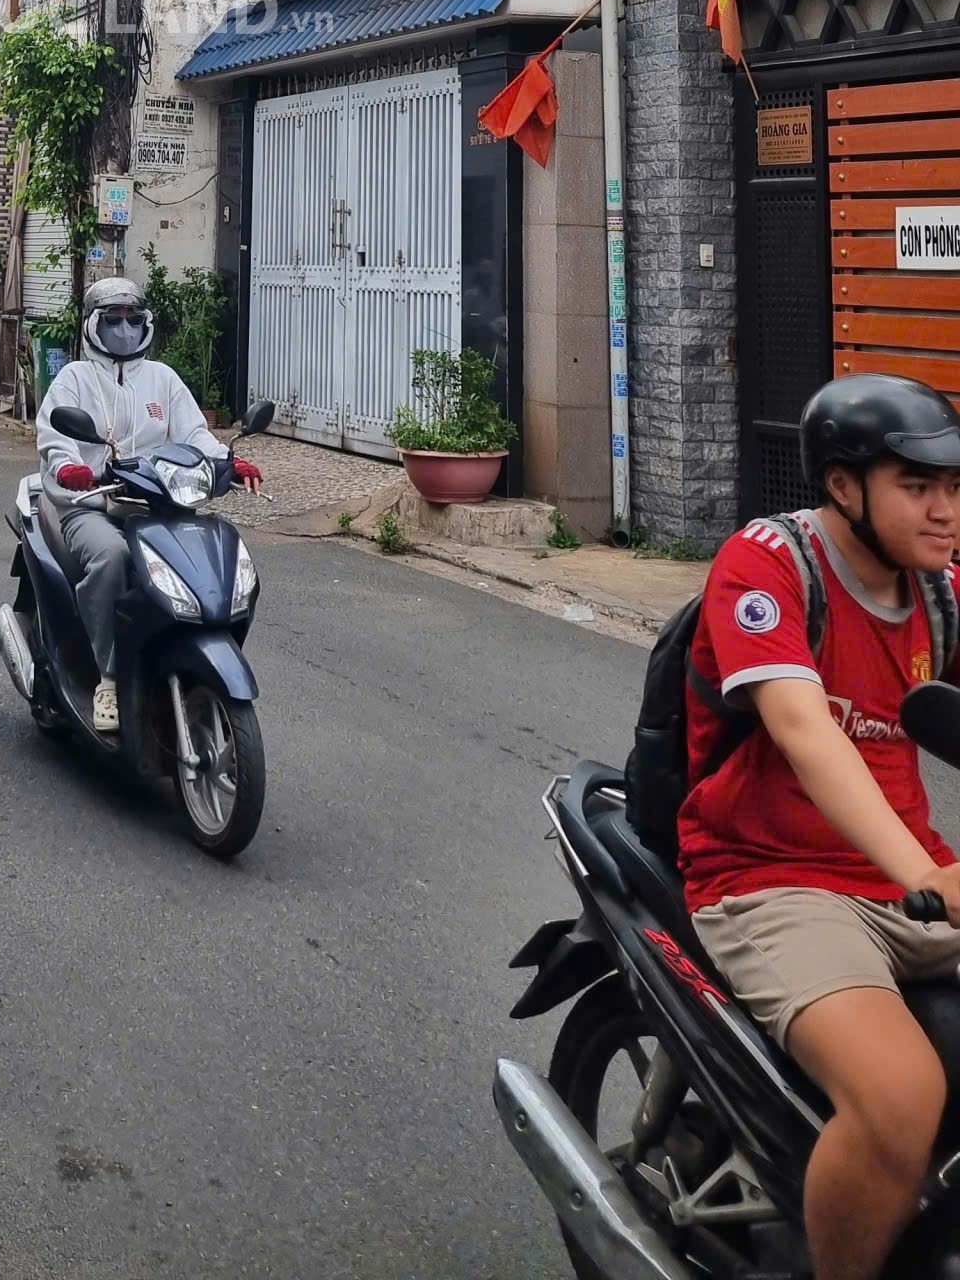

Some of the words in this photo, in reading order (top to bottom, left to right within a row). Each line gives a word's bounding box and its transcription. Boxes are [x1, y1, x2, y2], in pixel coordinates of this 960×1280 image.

[761, 121, 790, 138] HOÀNG
[792, 122, 808, 136] GIA
[171, 141, 186, 150] NHÀ
[900, 217, 922, 257] CÒN
[925, 217, 960, 257] PHÒNG
